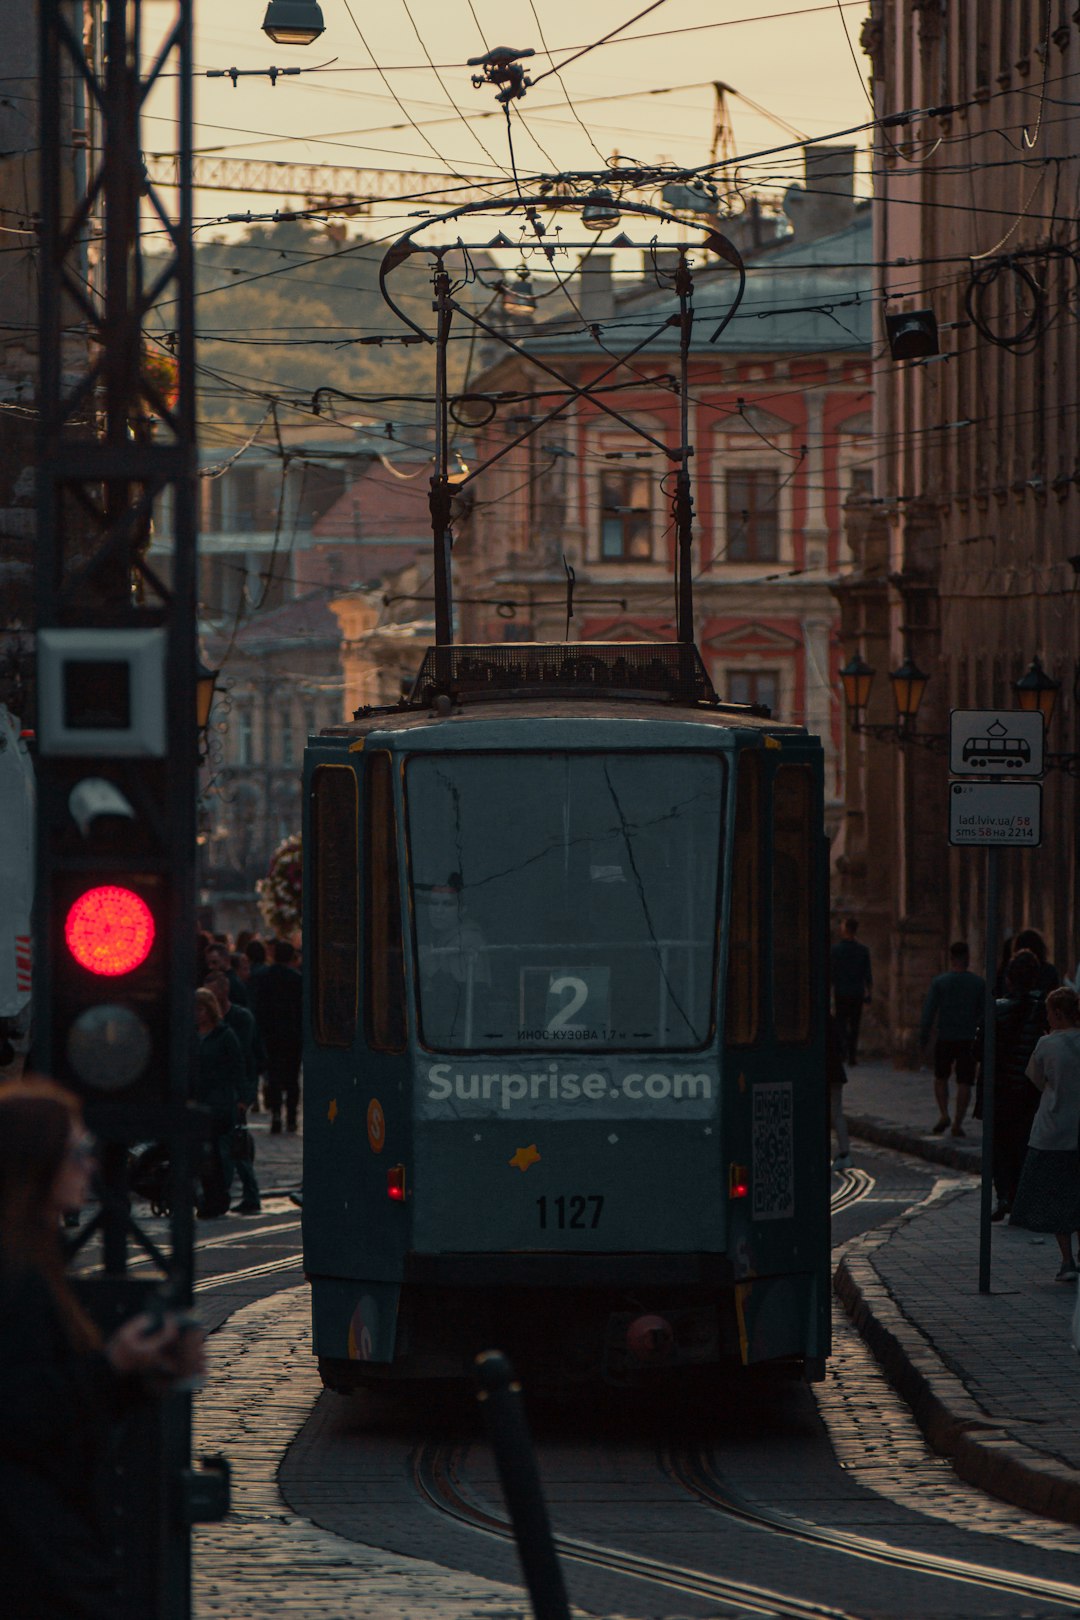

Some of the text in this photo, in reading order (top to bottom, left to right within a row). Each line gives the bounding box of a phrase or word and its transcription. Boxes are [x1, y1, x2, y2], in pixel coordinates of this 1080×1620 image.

[956, 828, 977, 837] sms
[978, 827, 992, 837] 58
[1008, 828, 1033, 837] 2214
[1017, 816, 1030, 826] 58
[548, 976, 589, 1032] 2
[553, 1030, 598, 1040] КУЗОВА
[428, 1063, 711, 1109] Surprise.com
[536, 1195, 605, 1229] 1127
